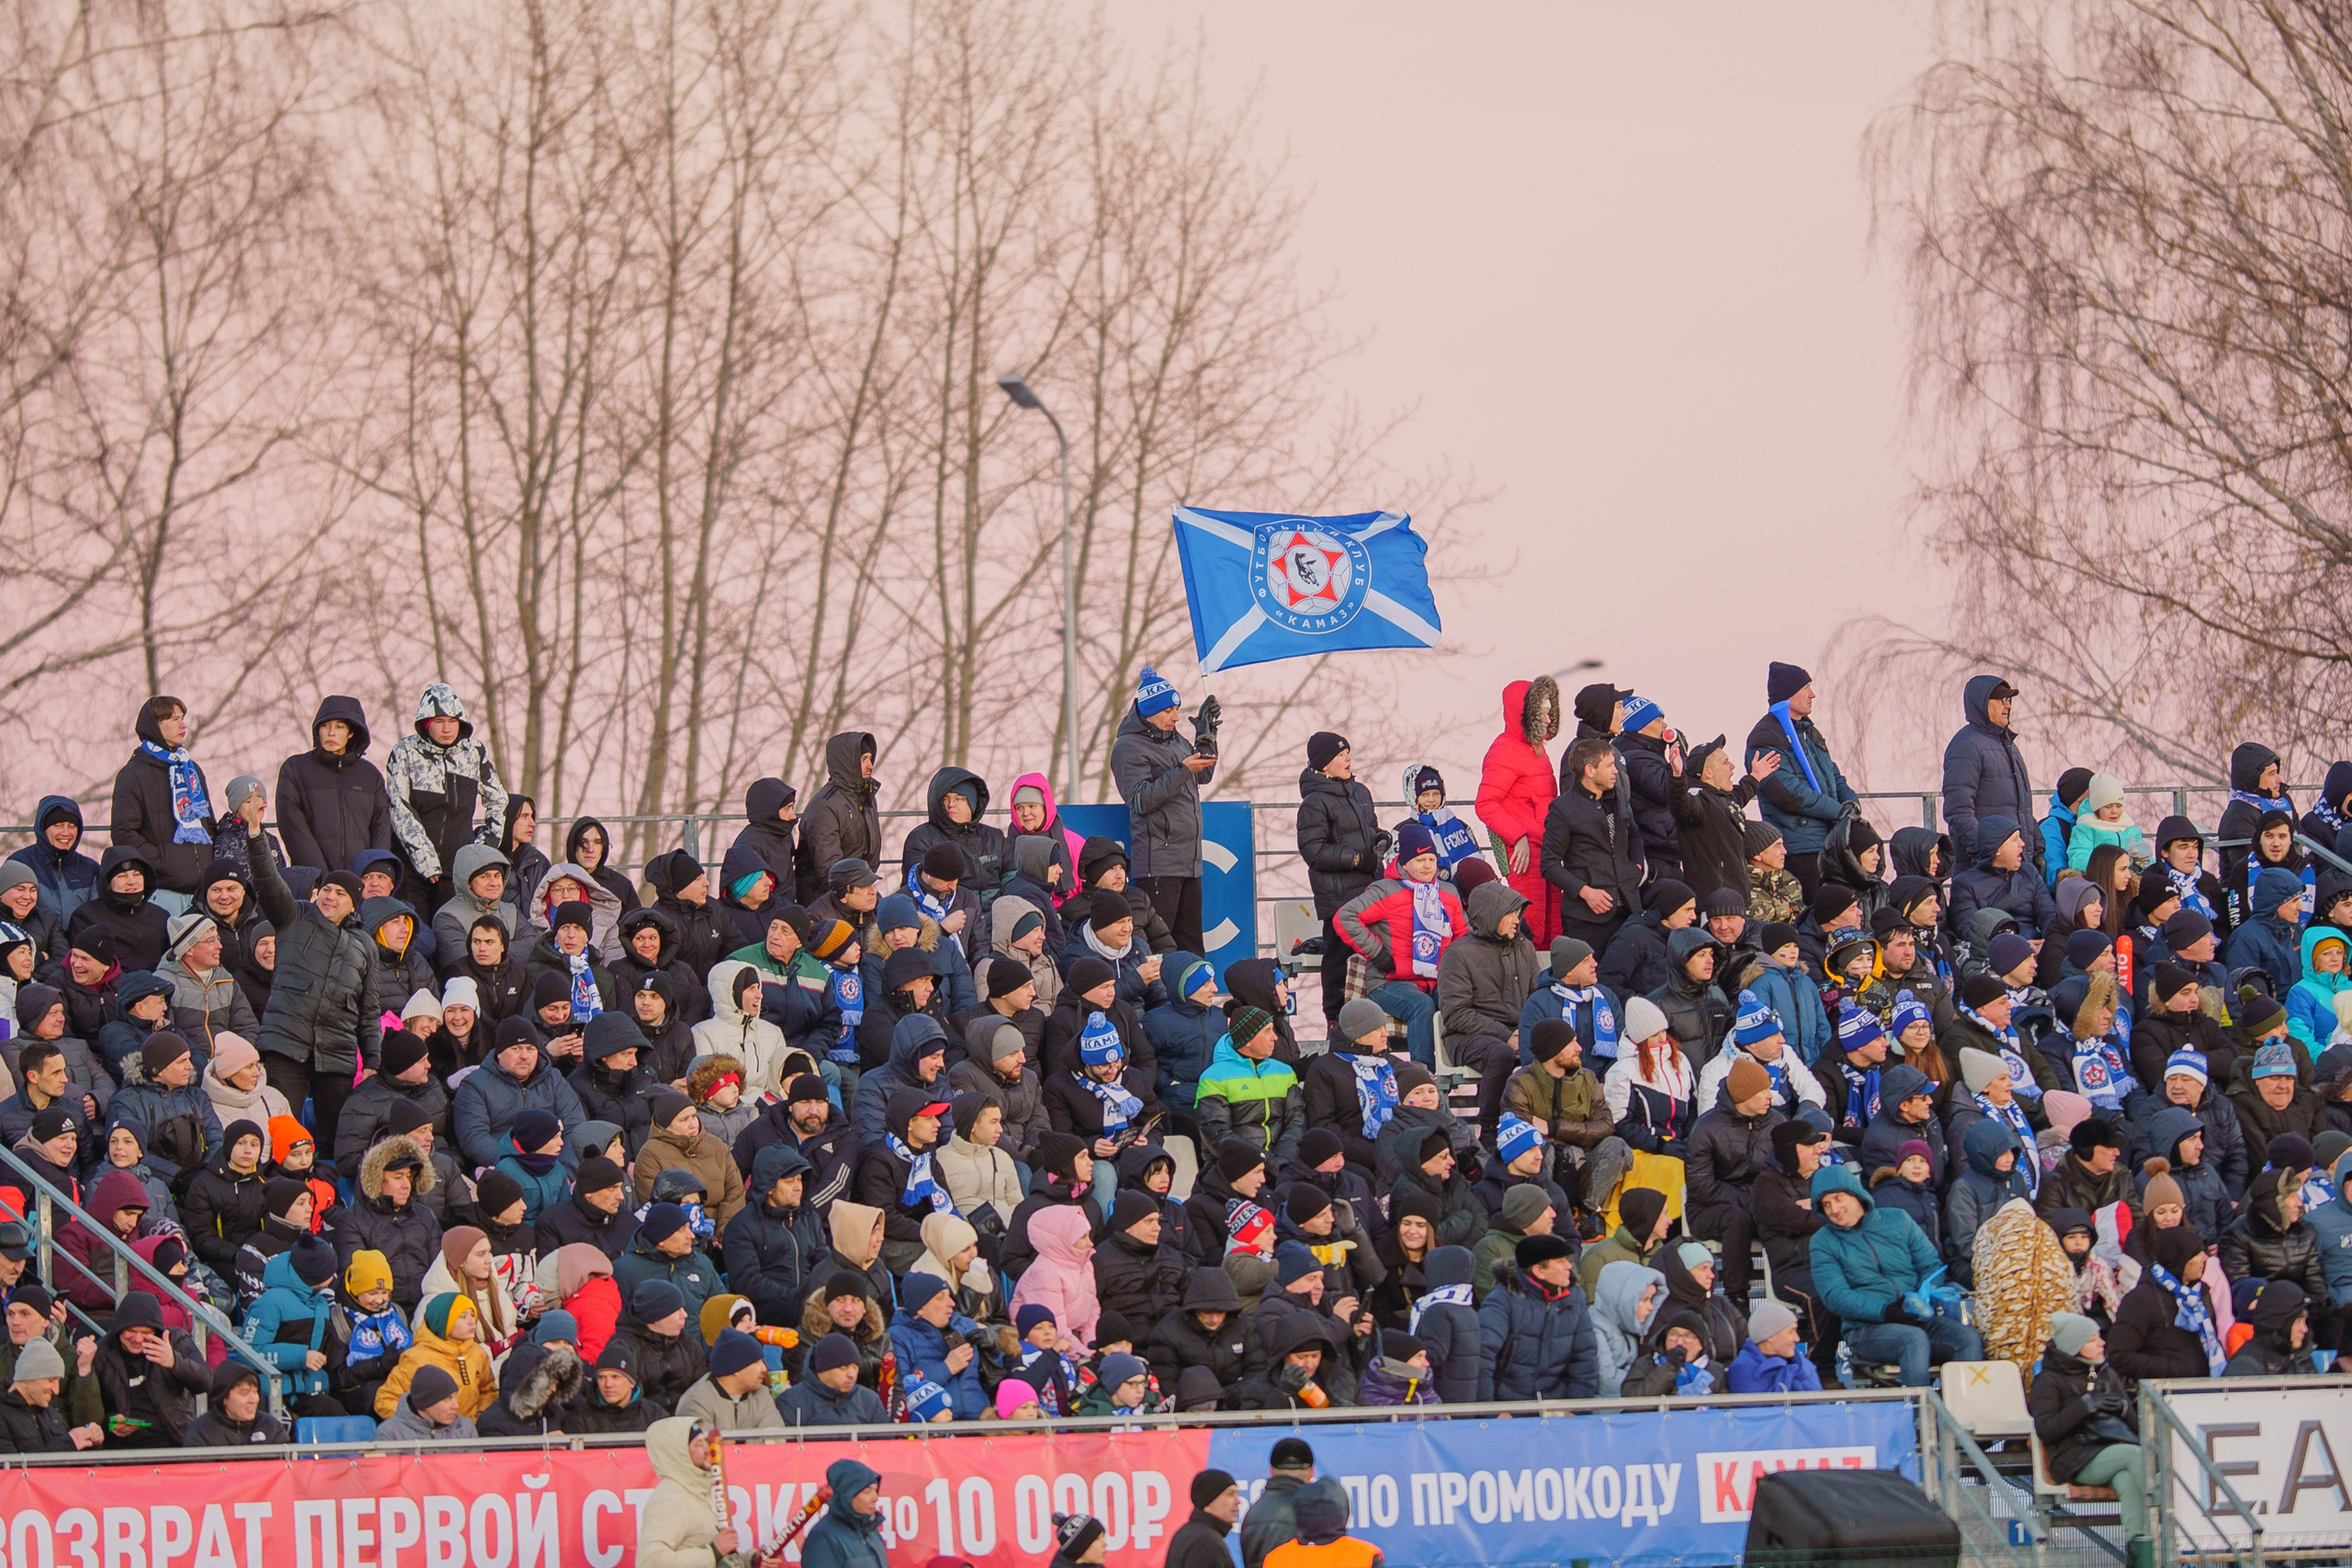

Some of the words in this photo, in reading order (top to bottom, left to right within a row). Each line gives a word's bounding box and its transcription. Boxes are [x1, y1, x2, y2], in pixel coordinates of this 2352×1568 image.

[1345, 540, 1365, 586] КЛУБ
[1443, 829, 1469, 851] FCKC
[1084, 1035, 1118, 1048] КАМА
[711, 1463, 729, 1530] OLIMPBE
[0, 1501, 272, 1568] ОЗВРАТ
[293, 1473, 560, 1568] ПЕРВОЙ
[926, 1475, 994, 1558] 10
[1340, 1473, 1400, 1529] ПО
[1410, 1461, 1682, 1528] ПРОМОКОДУ
[2015, 1522, 2024, 1543] 1
